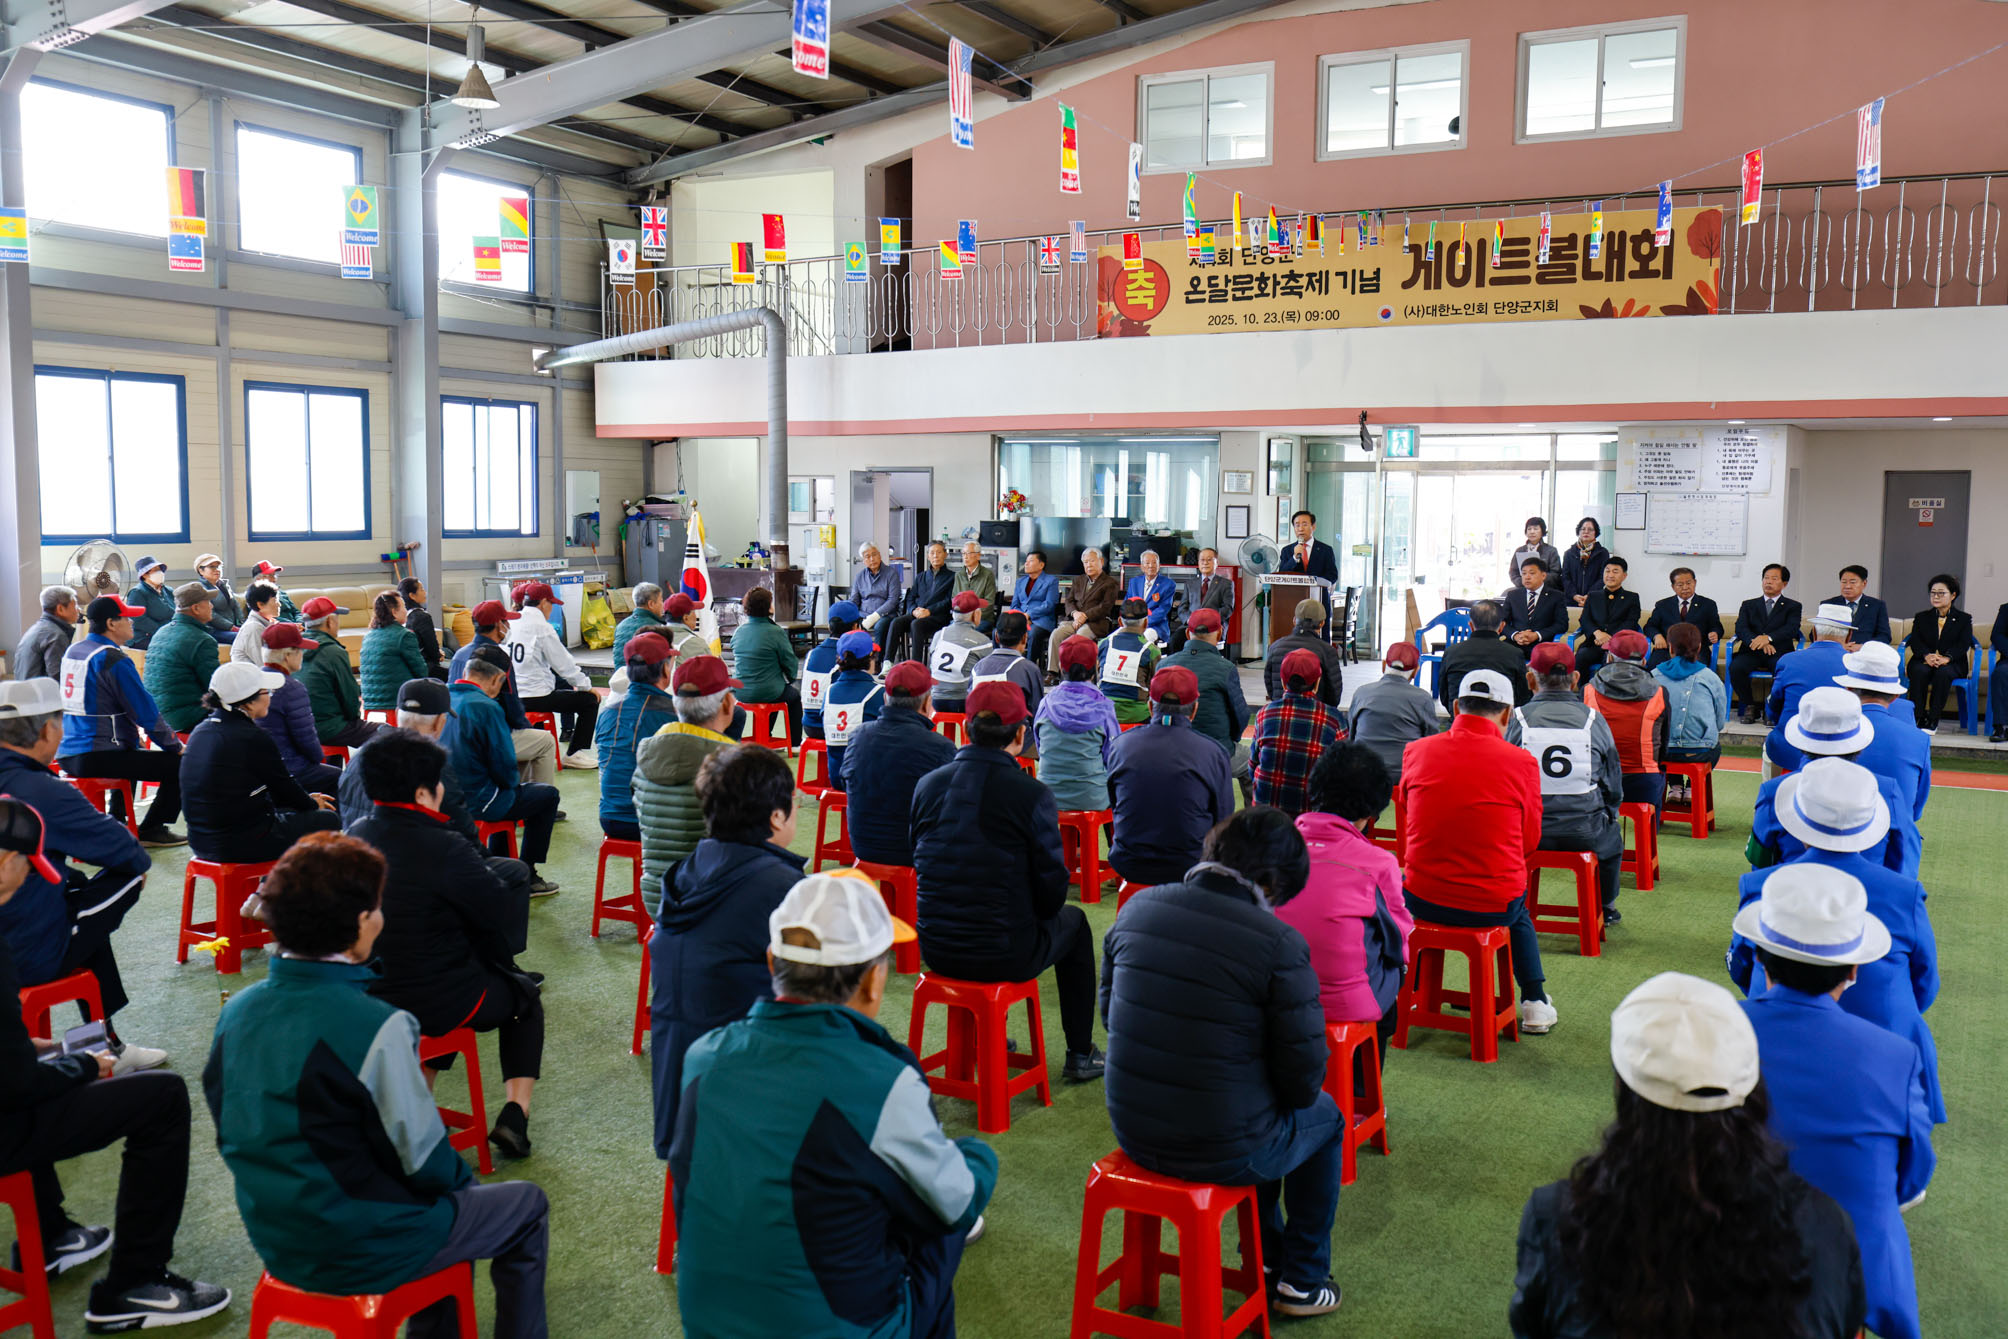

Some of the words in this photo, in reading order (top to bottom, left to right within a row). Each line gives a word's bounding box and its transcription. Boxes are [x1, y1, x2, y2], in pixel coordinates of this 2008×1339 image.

[0, 250, 28, 260] elcome
[171, 260, 202, 269] Welcome
[1400, 228, 1675, 291] 게이트볼대회
[1126, 269, 1156, 310] 축
[1184, 269, 1329, 304] 온달문화축제
[1335, 267, 1381, 296] 기념
[1208, 313, 1238, 326] 2025.
[1243, 312, 1260, 325] 10.
[1264, 310, 1301, 325] 23.(목)
[1304, 309, 1340, 322] 09:00
[1403, 302, 1489, 319] (사)대한노인회
[1493, 299, 1559, 315] 단양군지회
[507, 641, 525, 664] 10
[938, 652, 955, 673] 2
[1117, 654, 1129, 671] 7
[65, 673, 75, 699] 5
[810, 679, 819, 697] 9
[836, 710, 848, 731] 3
[1541, 744, 1573, 779] 6
